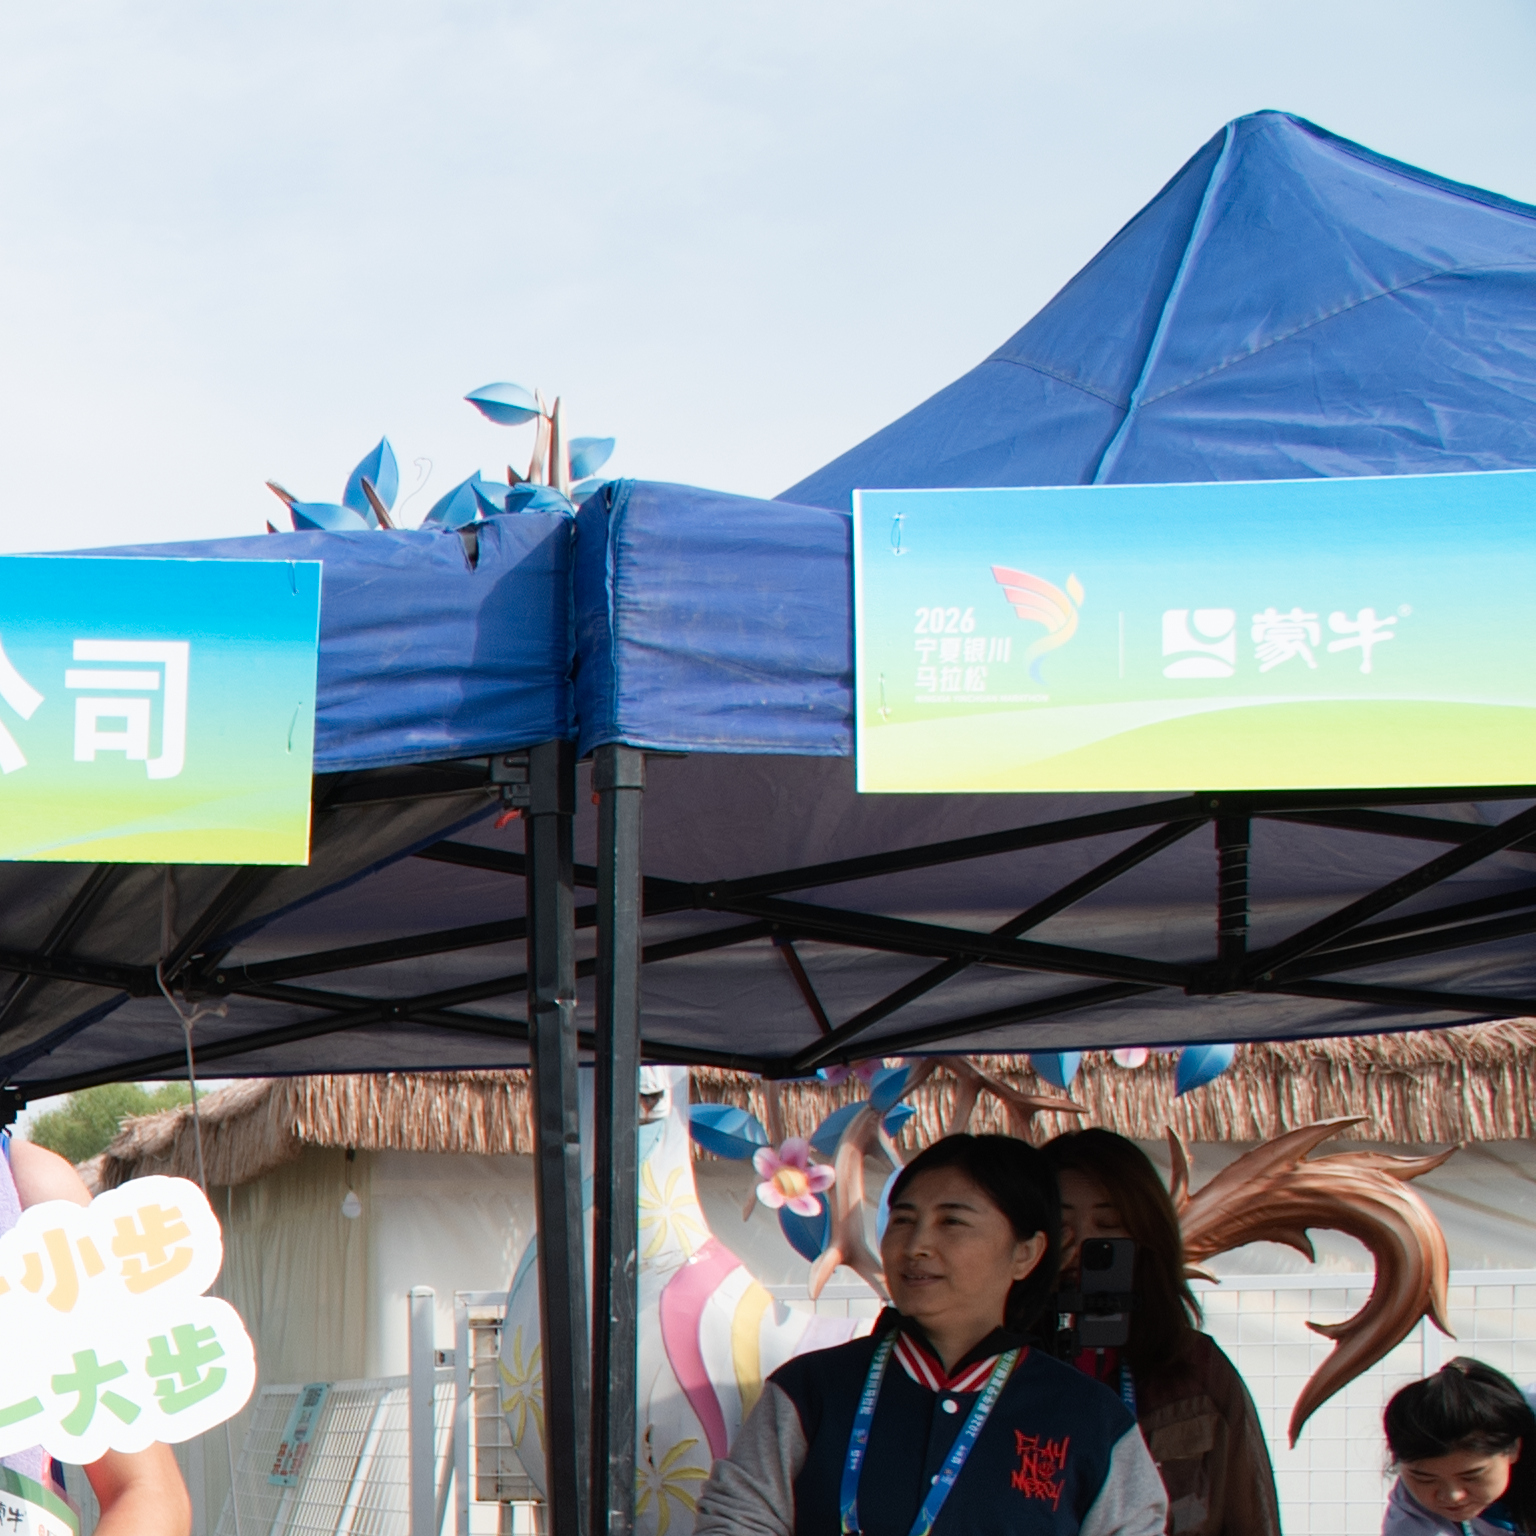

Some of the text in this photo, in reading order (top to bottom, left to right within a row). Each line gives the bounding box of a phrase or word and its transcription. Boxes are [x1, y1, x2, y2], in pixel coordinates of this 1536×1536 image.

[914, 607, 976, 634] 2026
[914, 637, 1012, 664] 宁夏银川
[1250, 607, 1399, 675] 蒙牛
[914, 666, 988, 693] 马拉松
